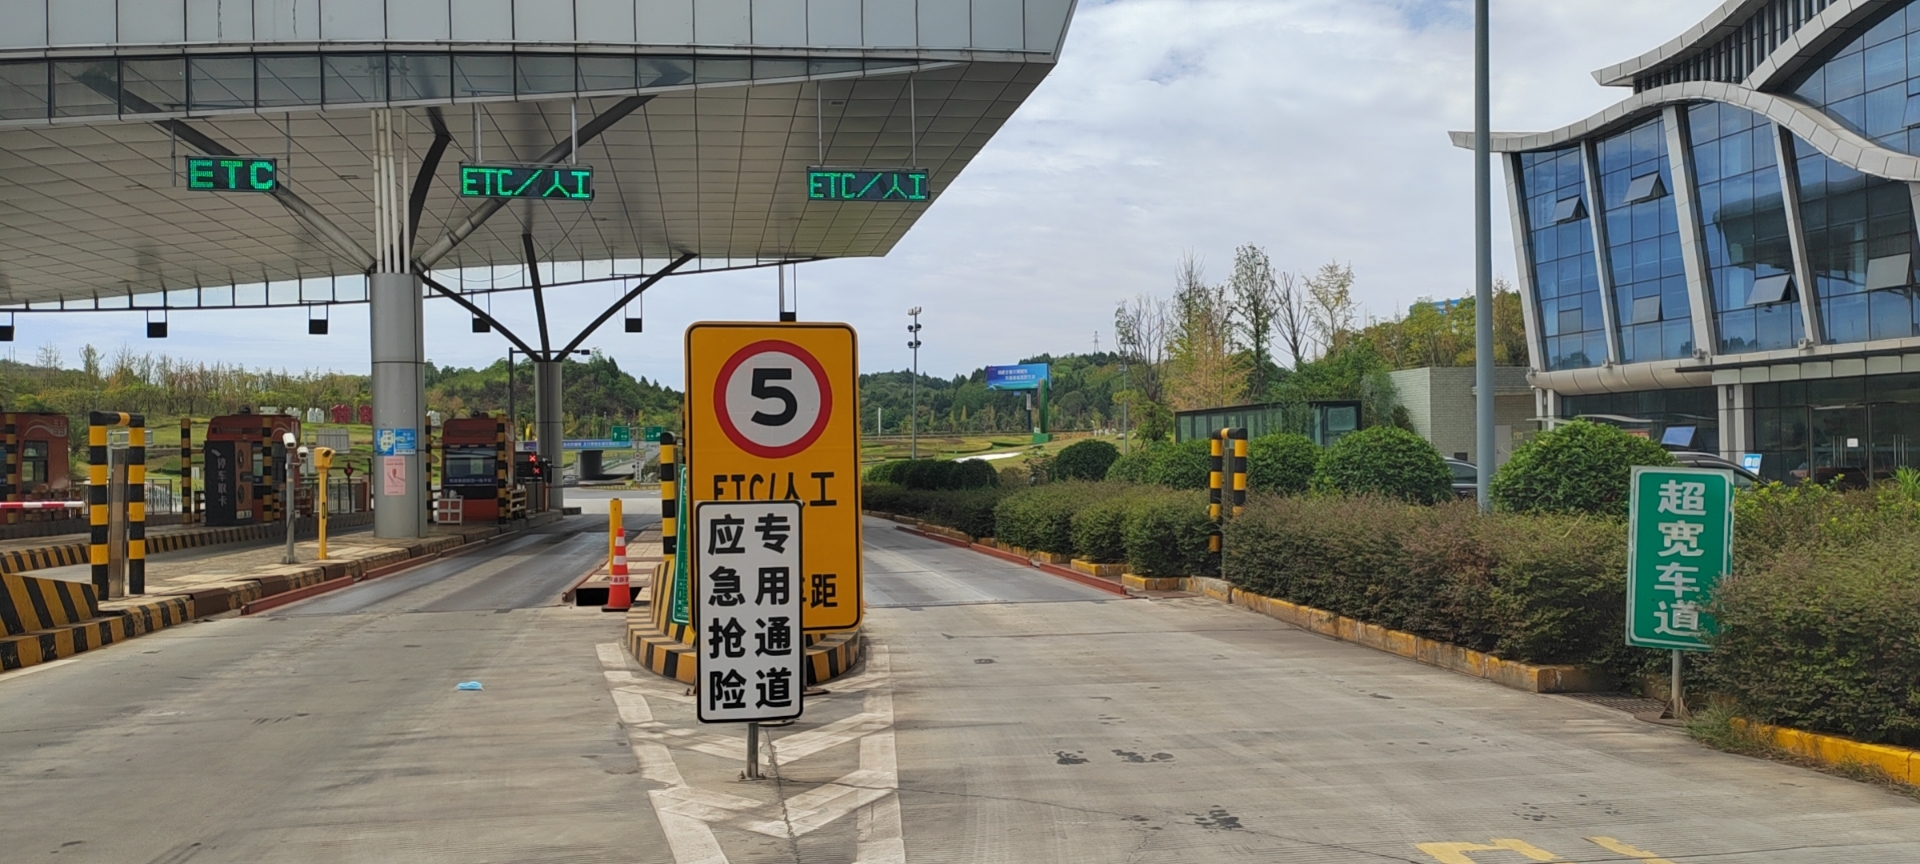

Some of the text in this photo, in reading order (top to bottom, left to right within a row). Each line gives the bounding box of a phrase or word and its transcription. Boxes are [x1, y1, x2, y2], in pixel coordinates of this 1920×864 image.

[190, 160, 272, 189] ETC
[463, 168, 589, 198] ETC/人工
[810, 173, 925, 199] ETC/人工
[751, 368, 797, 426] 5
[713, 472, 837, 507] ETC/人工
[1653, 479, 1707, 637] 超宽车道
[708, 514, 746, 710] 应急抢险
[755, 514, 791, 708] 专用通道
